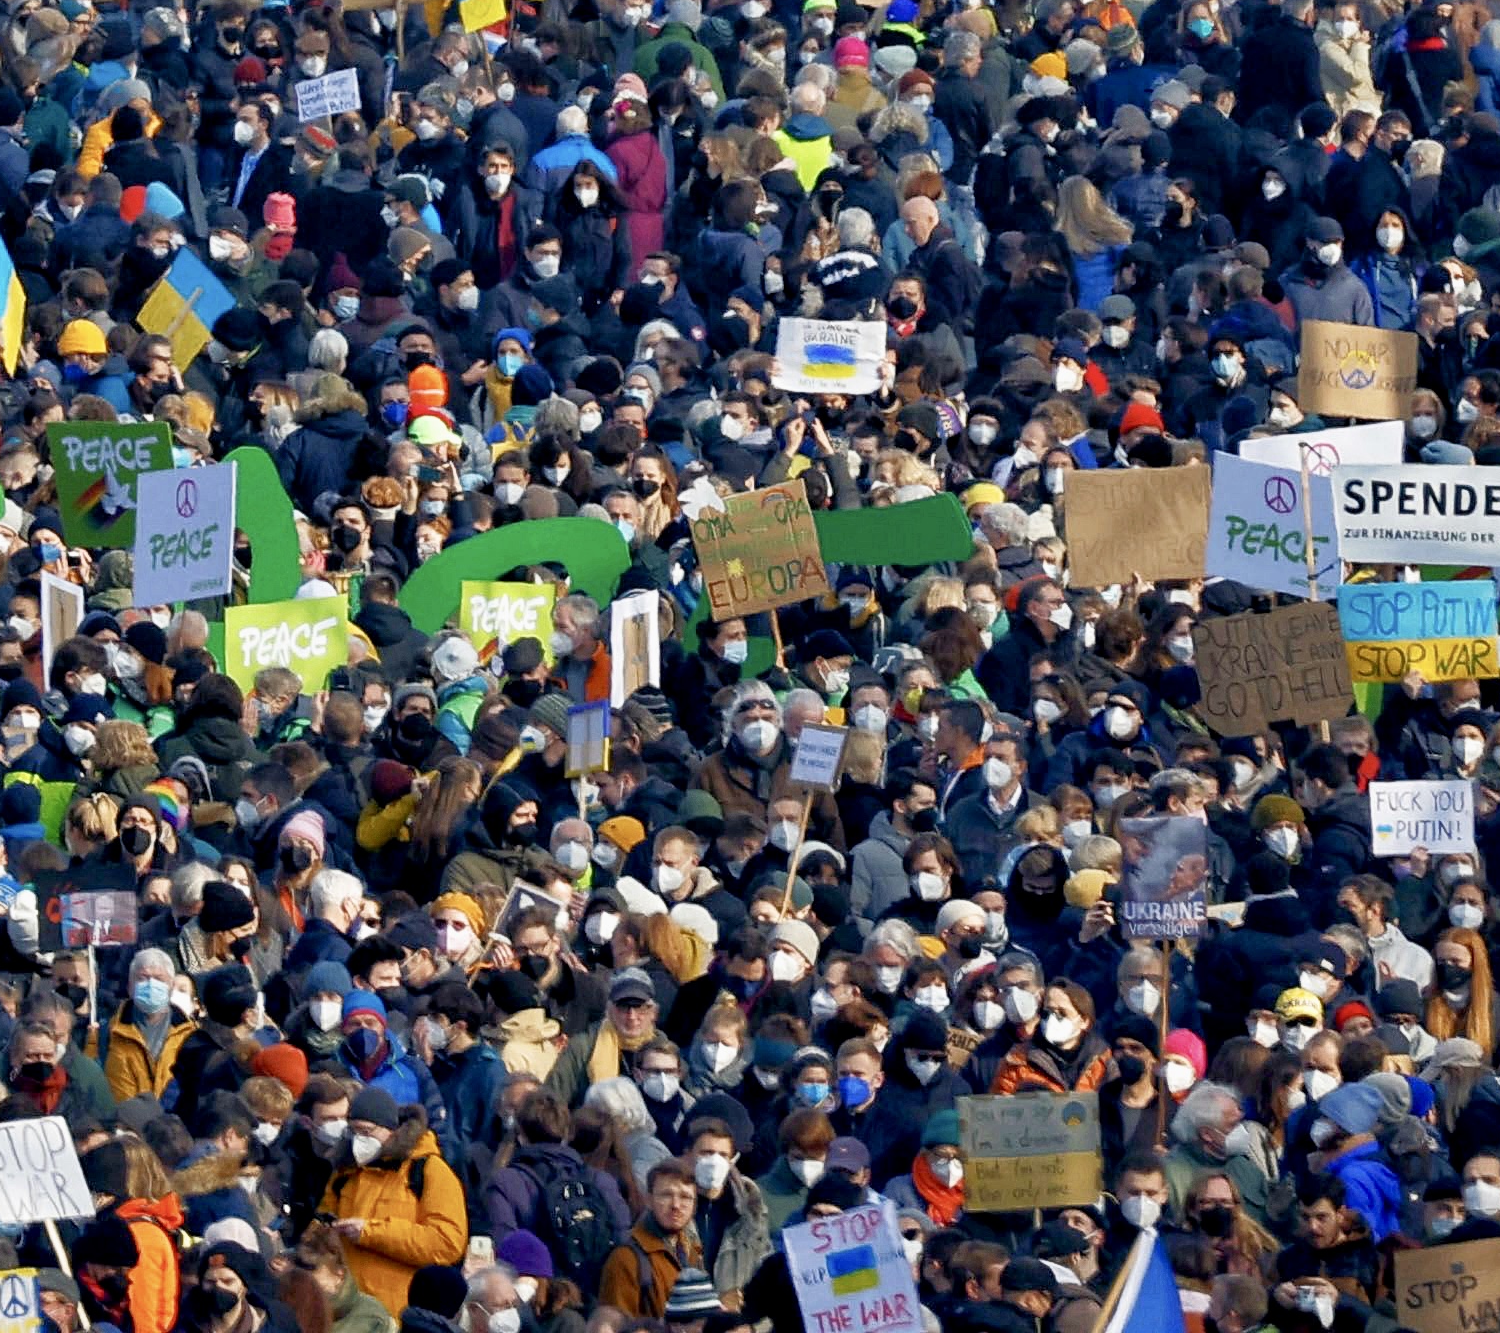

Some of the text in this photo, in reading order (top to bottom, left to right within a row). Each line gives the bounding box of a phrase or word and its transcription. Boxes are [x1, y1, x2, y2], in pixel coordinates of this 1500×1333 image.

[804, 333, 857, 346] UKRAINE
[1324, 340, 1347, 359] NO
[62, 435, 158, 473] PEACE
[694, 499, 810, 543] OMA OPA
[1344, 527, 1370, 540] ZUR
[1373, 528, 1467, 542] FINANZIERUNG
[1471, 532, 1495, 544] DER
[149, 525, 219, 571] PEACE
[1224, 516, 1330, 566] PEACE
[708, 555, 827, 609] EUROPA
[470, 593, 544, 633] PEACE
[1349, 588, 1497, 636] STOP PUTIN
[239, 617, 337, 668] PEACE
[1356, 639, 1493, 677] STOP WAR
[1207, 669, 1353, 718] GO TO HELL
[1375, 791, 1419, 812] FUCK
[1398, 819, 1463, 842] PUTIN!
[1123, 900, 1206, 921] UKRAINE
[0, 1172, 81, 1222] WAR
[811, 1209, 882, 1253] STOP
[1406, 1275, 1478, 1309] STOP
[811, 1294, 912, 1333] THE WAR
